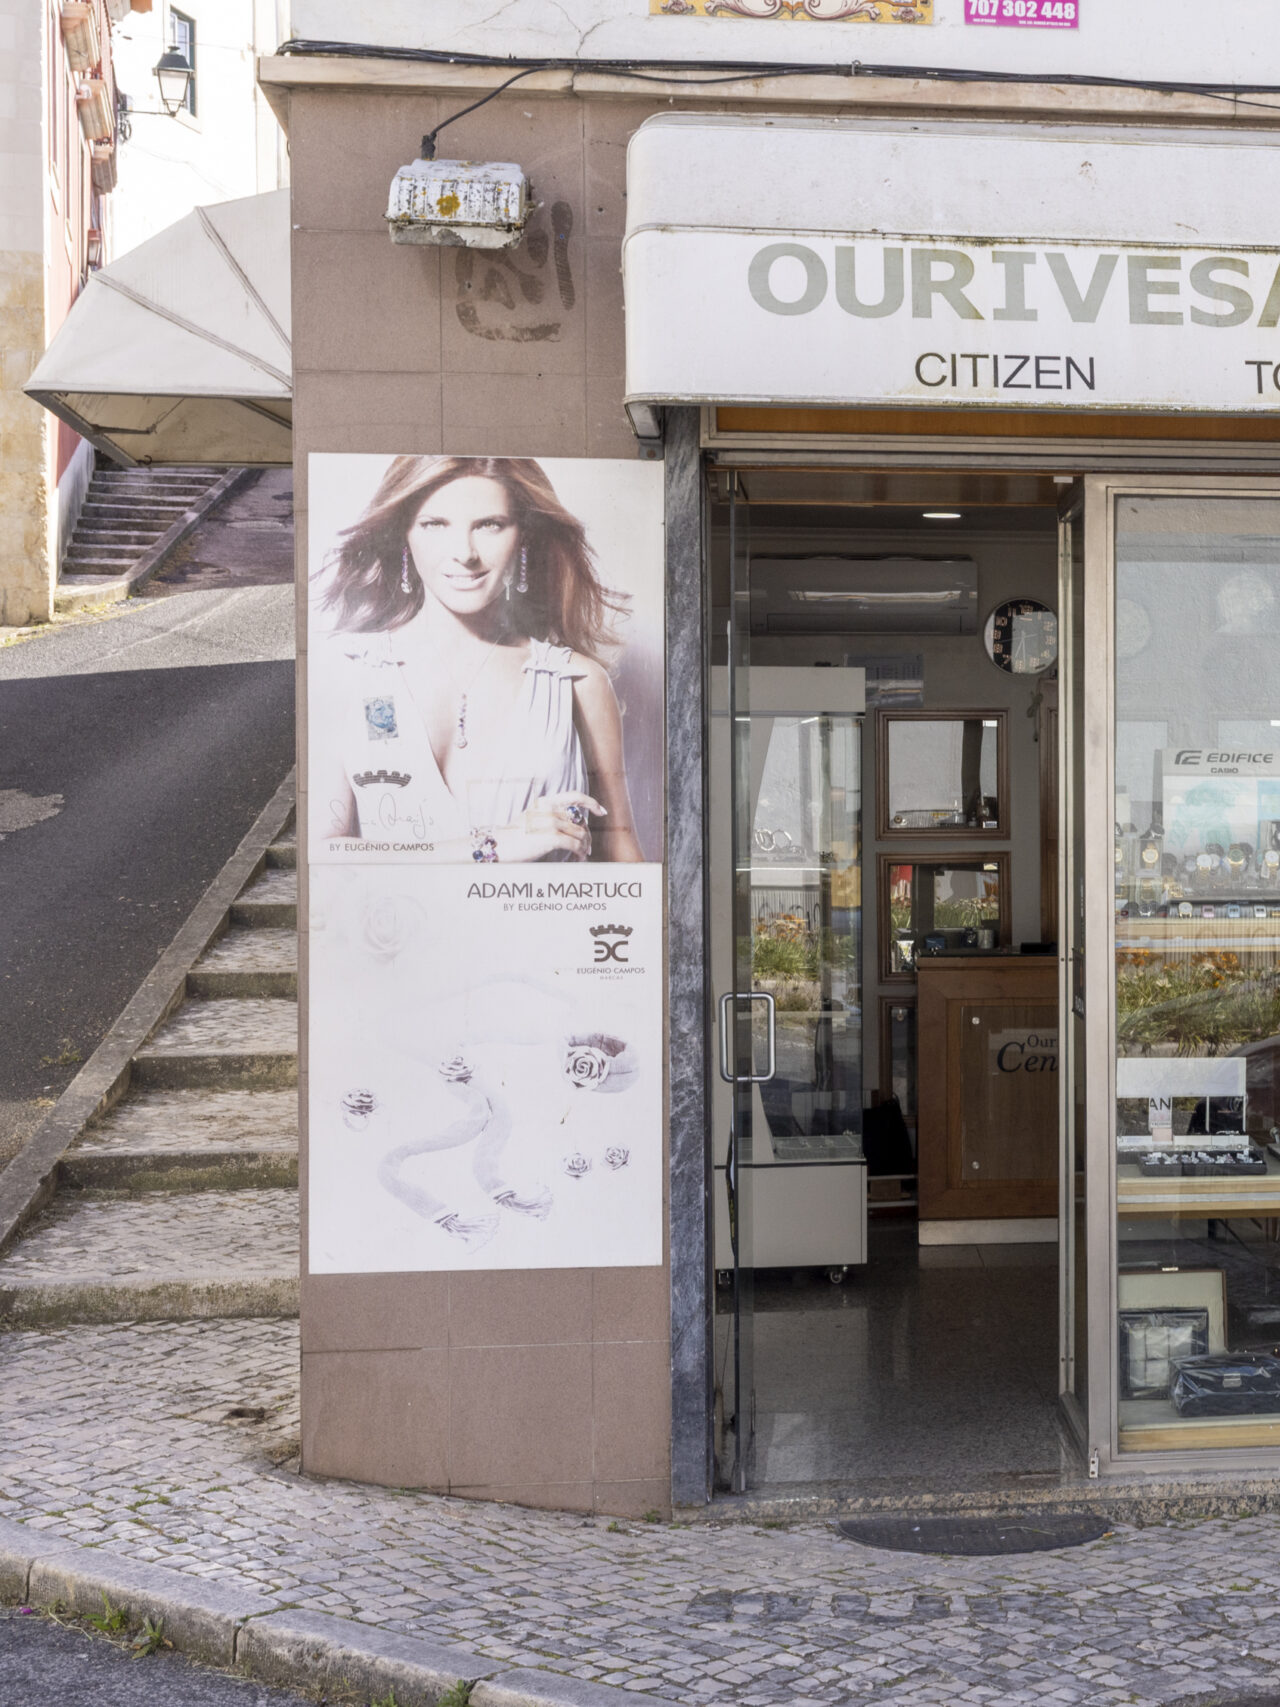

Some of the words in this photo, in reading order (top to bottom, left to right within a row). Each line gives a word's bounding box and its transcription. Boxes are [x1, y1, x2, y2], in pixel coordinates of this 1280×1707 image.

[968, 0, 998, 16] 707
[1002, 0, 1037, 18] 302
[1040, 2, 1075, 19] 448
[915, 351, 1096, 391] CITIZEN
[1206, 752, 1274, 764] EDIFICE
[329, 843, 340, 852] BY
[344, 841, 390, 852] EUGÉNIO
[392, 842, 435, 852] CAMPOS
[467, 882, 532, 898] ADAMI
[536, 887, 545, 898] &
[548, 882, 642, 898] MARTUCCI
[503, 903, 514, 912] BY
[518, 901, 563, 912] EUGÉNIO
[566, 902, 607, 911] CAMPOS
[613, 967, 646, 975] CAMPOS
